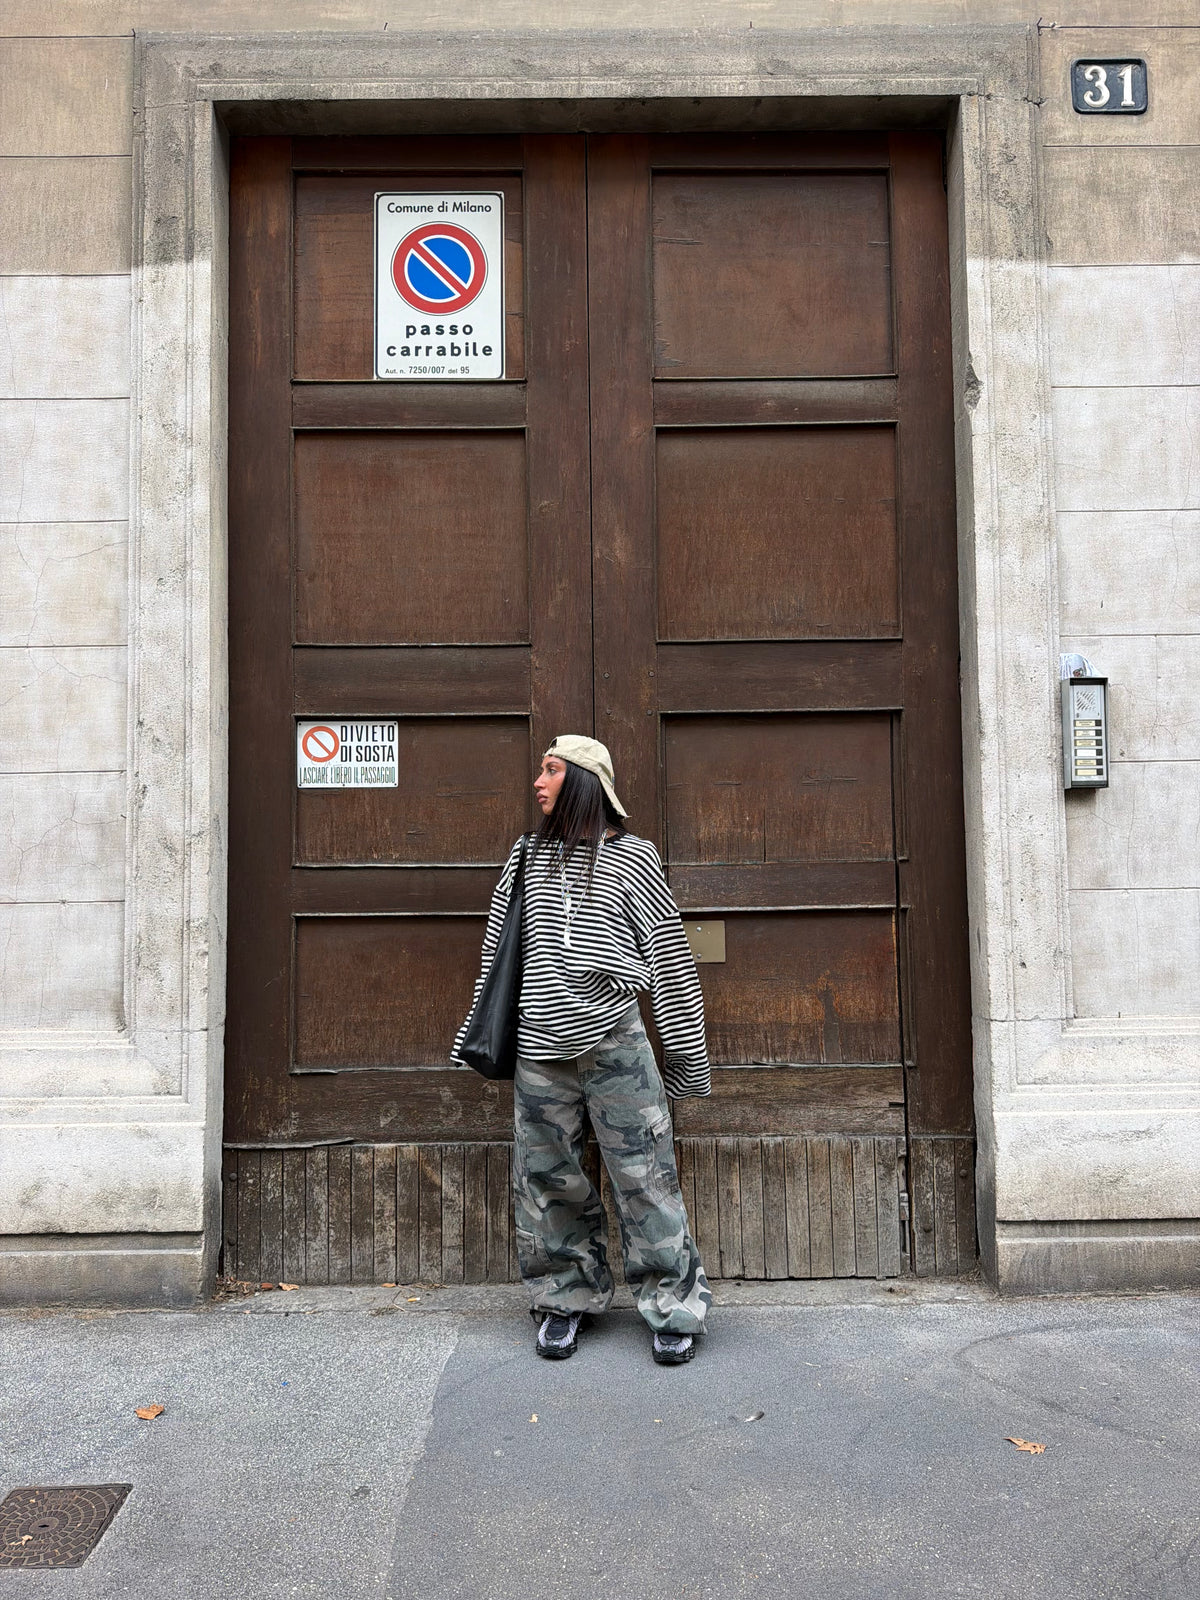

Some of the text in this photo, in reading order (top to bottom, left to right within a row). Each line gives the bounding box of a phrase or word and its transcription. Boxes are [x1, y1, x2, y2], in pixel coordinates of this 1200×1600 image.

[1083, 65, 1136, 108] 31
[387, 201, 492, 214] Comune di Milano
[405, 324, 473, 338] passo
[386, 342, 493, 357] carrabile
[408, 366, 445, 374] 7250/007
[460, 366, 470, 374] 95
[340, 725, 395, 742] DIVIETO
[340, 745, 395, 762] DI SOSTA
[300, 766, 395, 784] LASCIARE LIBERO IL PASSAGGIO
